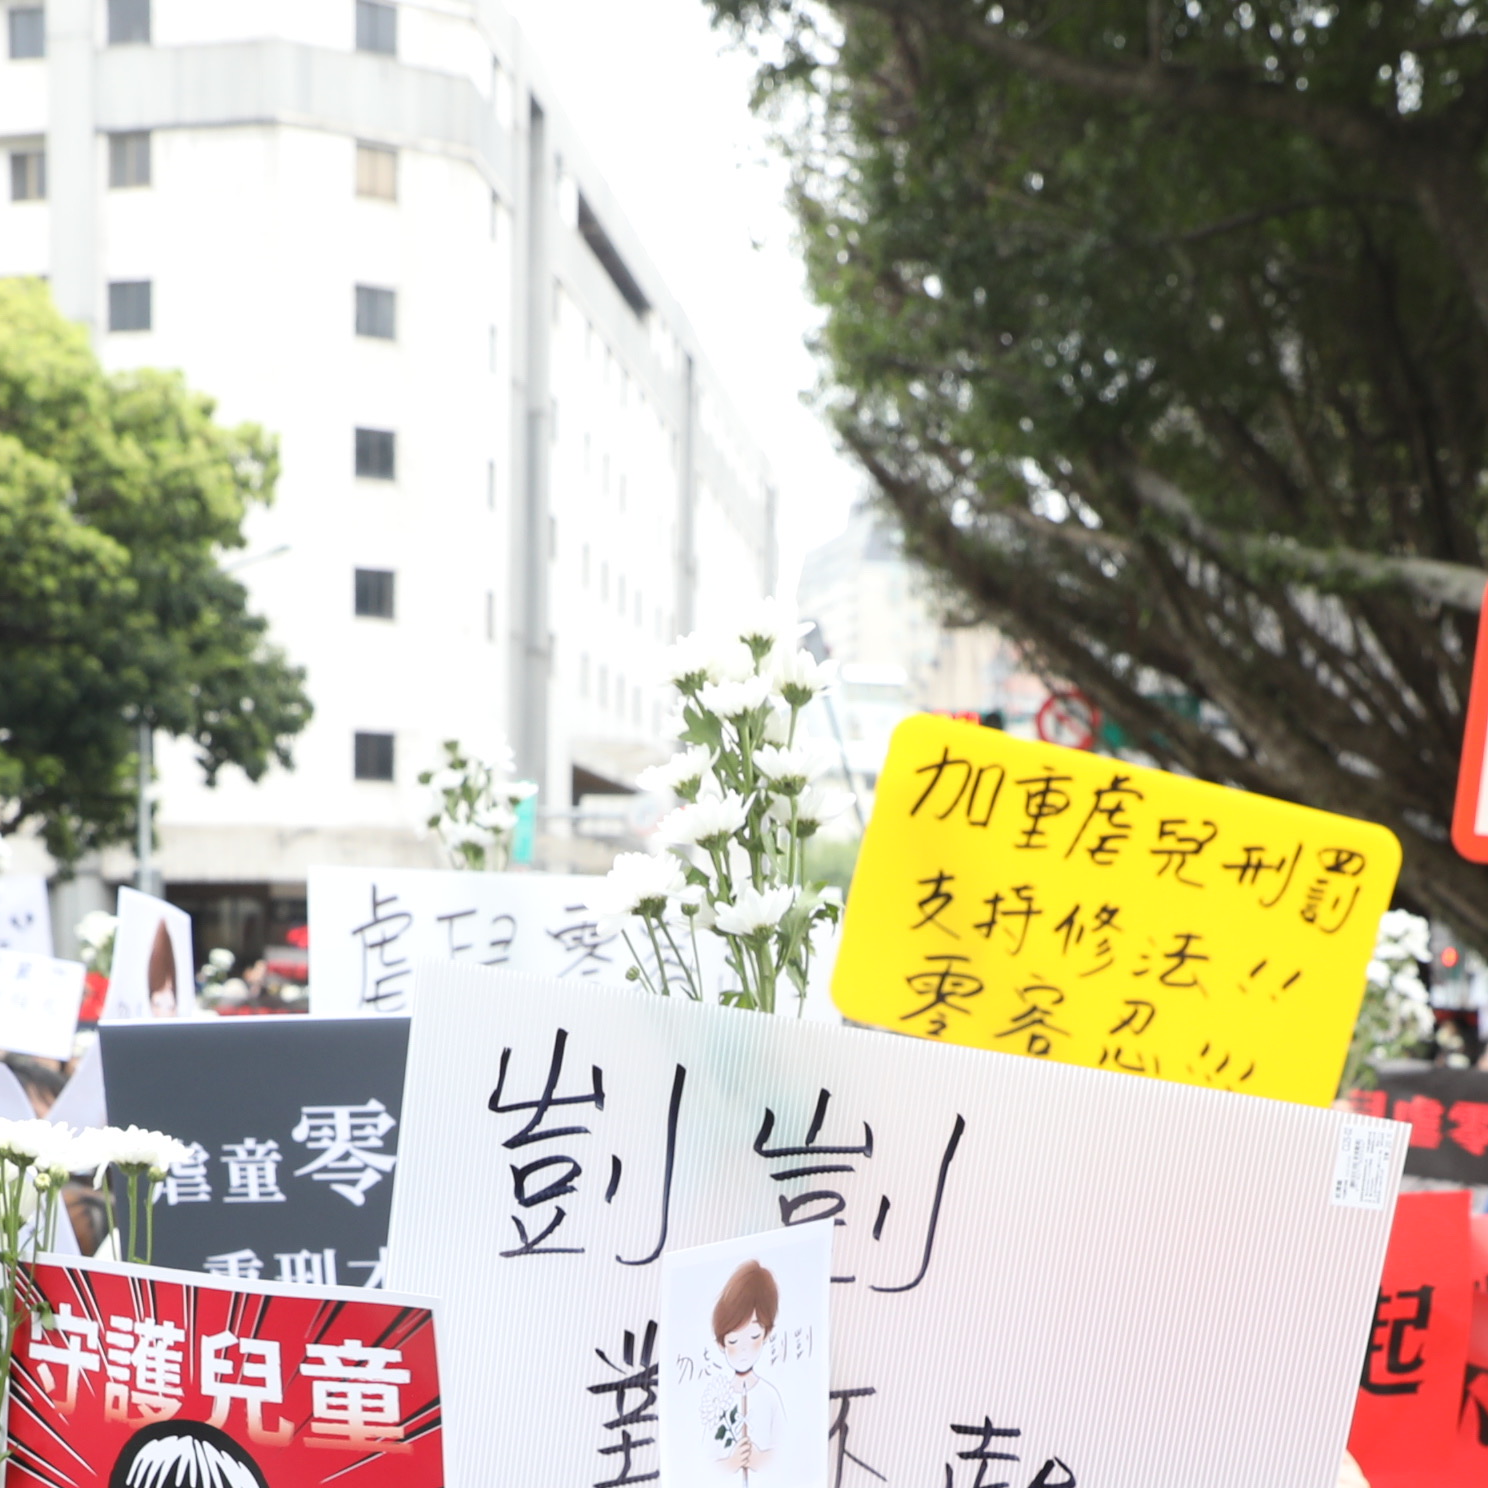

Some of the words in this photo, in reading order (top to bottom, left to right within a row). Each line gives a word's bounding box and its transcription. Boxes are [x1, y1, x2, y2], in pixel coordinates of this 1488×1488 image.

[910, 746, 1367, 935] 加重虐兒刑罰
[488, 1028, 967, 1295] 剴剴
[27, 1302, 416, 1457] 守護兒童
